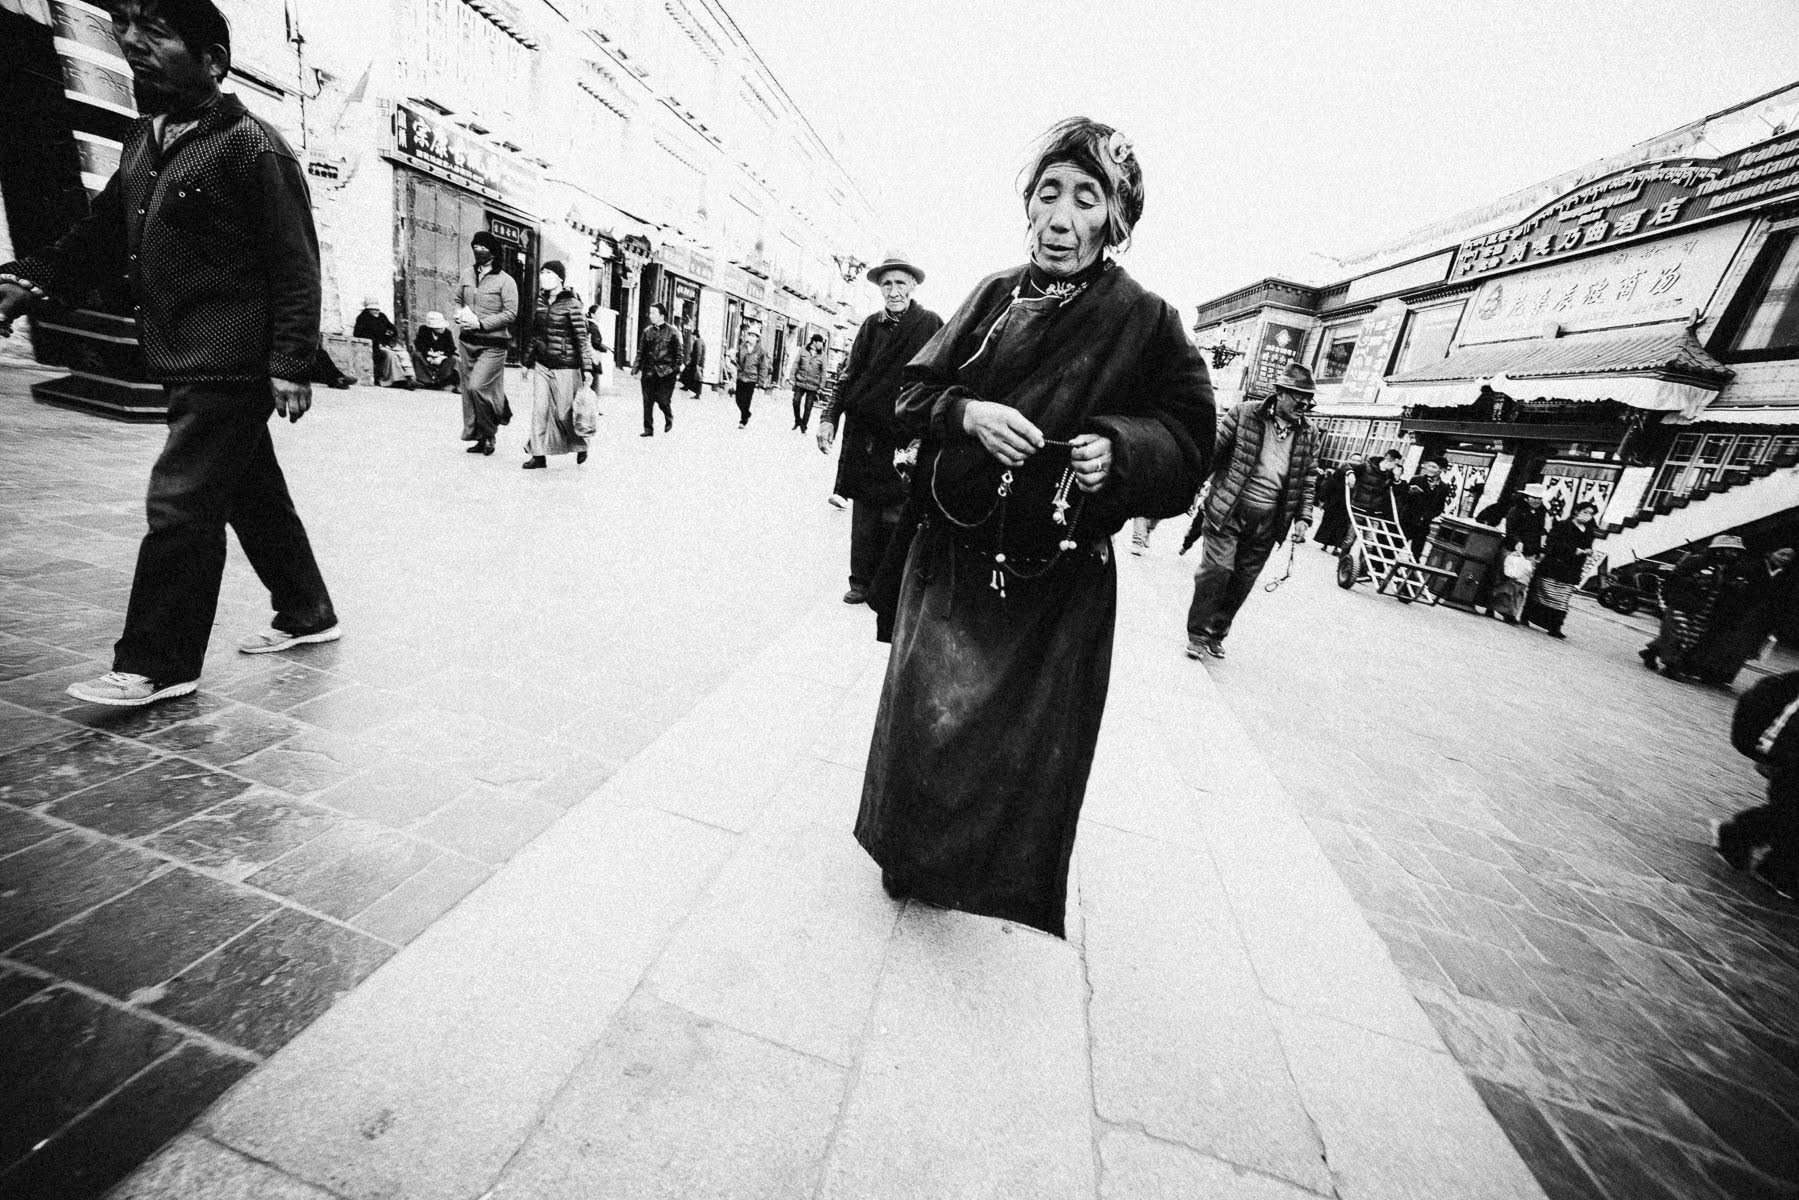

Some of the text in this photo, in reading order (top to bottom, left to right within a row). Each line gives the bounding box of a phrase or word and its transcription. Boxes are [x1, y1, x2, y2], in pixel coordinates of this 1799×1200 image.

[1738, 138, 1799, 168] Teahou
[1696, 153, 1799, 197] Tibet Restaur
